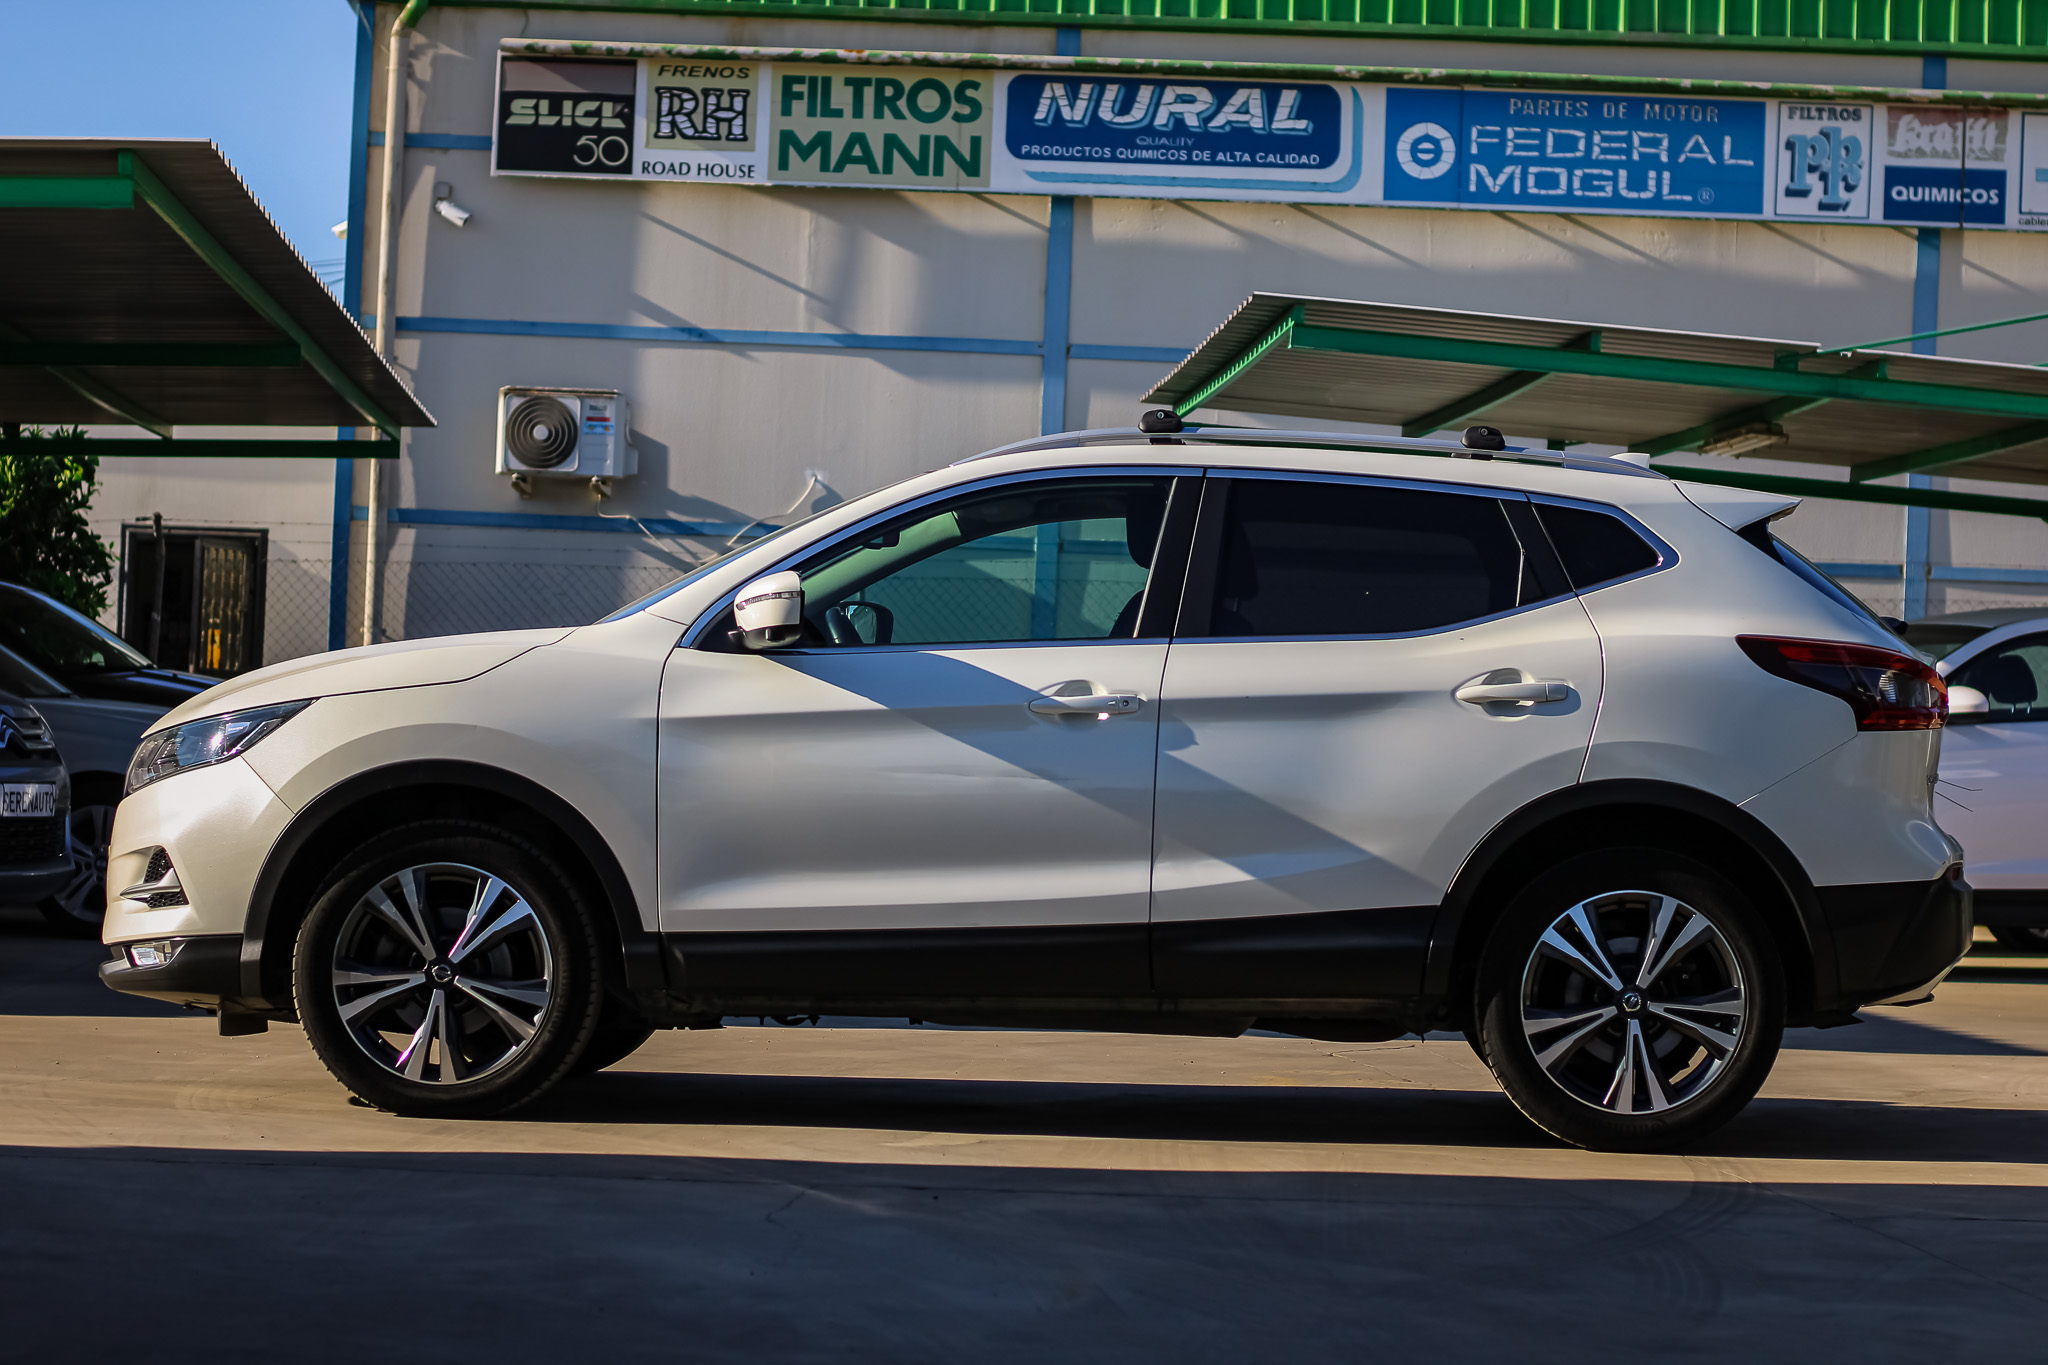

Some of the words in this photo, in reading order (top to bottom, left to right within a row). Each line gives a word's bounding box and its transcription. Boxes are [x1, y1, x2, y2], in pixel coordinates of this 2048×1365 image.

[658, 64, 751, 80] FRENOS
[780, 74, 983, 124] FILTROS
[1033, 82, 1314, 136] NURAL
[1509, 98, 1589, 119] PARTES
[1602, 102, 1628, 120] DE
[1644, 103, 1719, 123] MOTOR
[653, 86, 751, 142] RH
[1787, 106, 1863, 122] FILTROS
[573, 136, 629, 167] 50
[777, 129, 983, 178] MANN
[1136, 135, 1195, 148] QUALITY
[1471, 125, 1754, 167] FEDERAL
[1021, 144, 1112, 159] PRODUCTOS
[1116, 148, 1188, 162] QUIMICOS
[1192, 150, 1212, 163] DE
[1216, 151, 1252, 164] ALTA
[1255, 152, 1320, 166] CALIDAD
[641, 160, 691, 177] ROAD
[697, 162, 756, 179] HOUSE
[1468, 163, 1693, 202] MOGUL
[1891, 185, 2000, 205] QUIMICOS
[2018, 215, 2048, 226] cable
